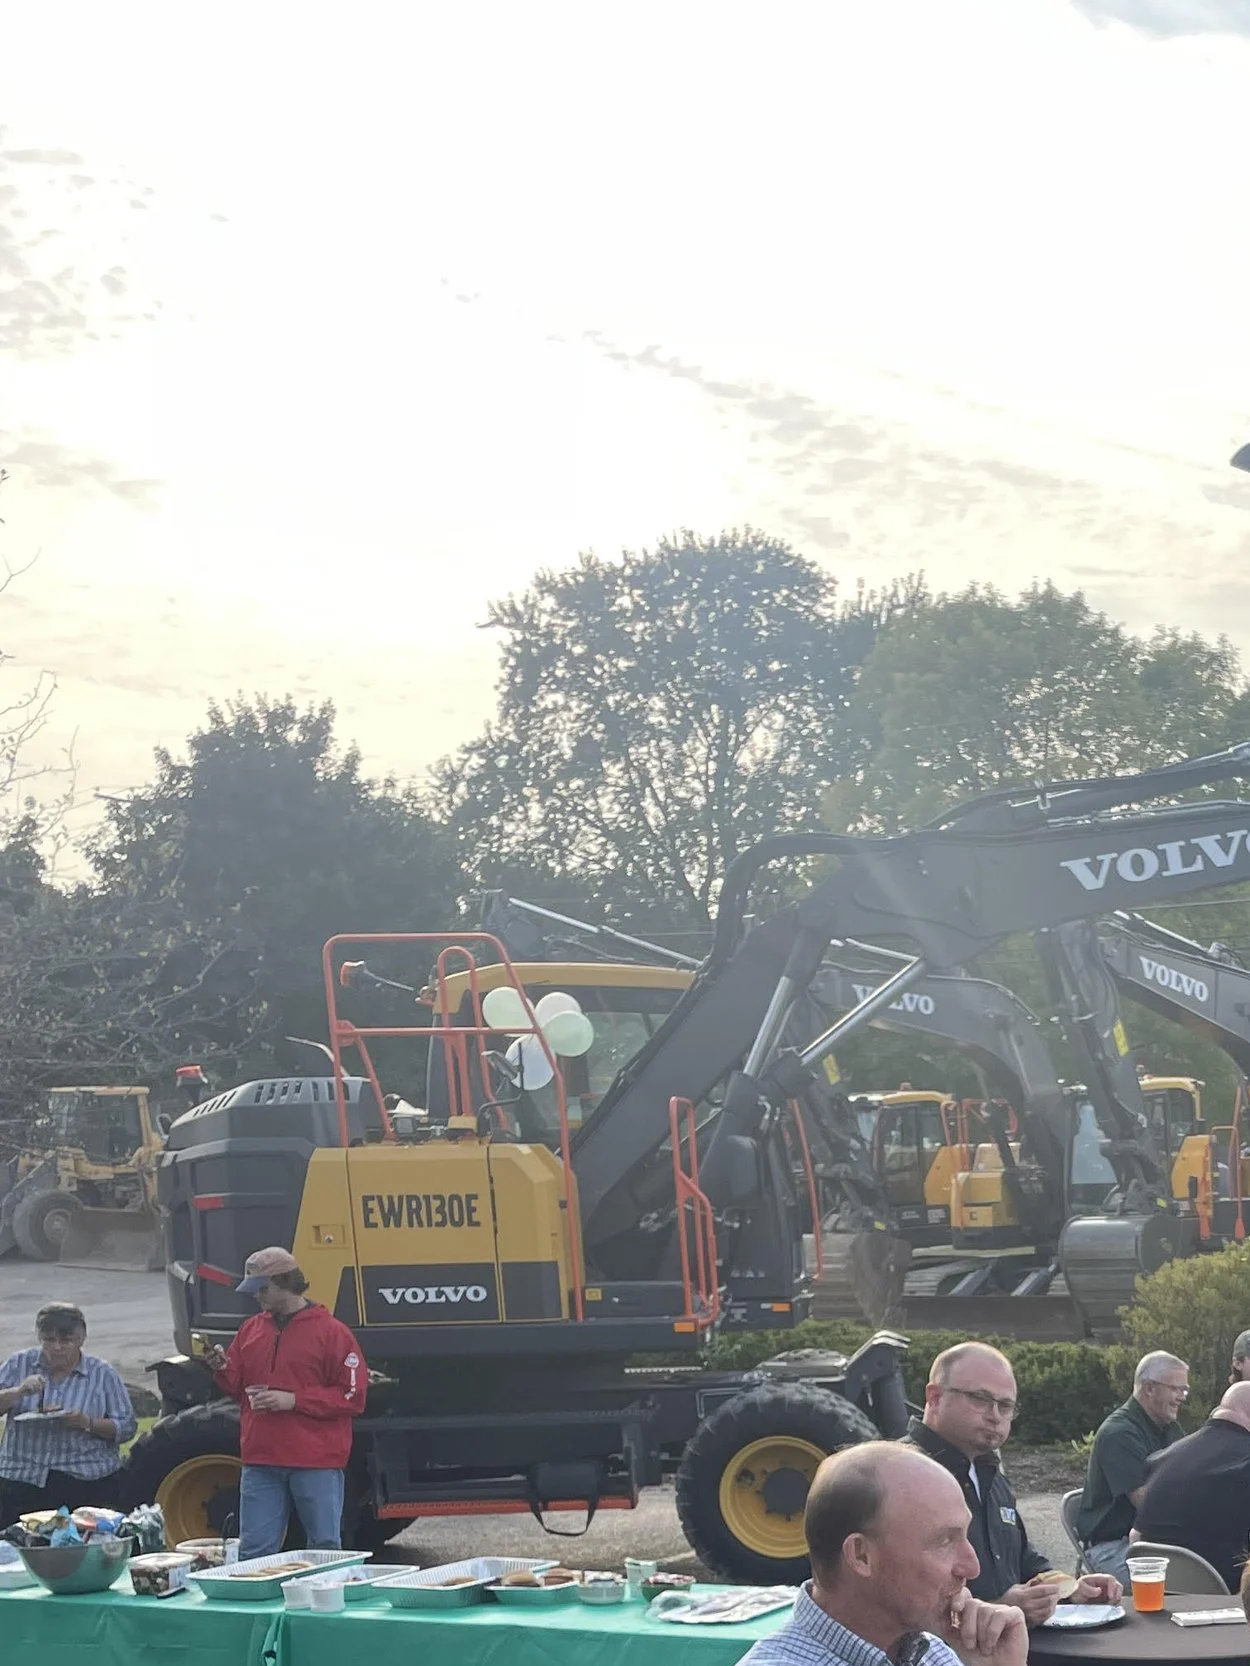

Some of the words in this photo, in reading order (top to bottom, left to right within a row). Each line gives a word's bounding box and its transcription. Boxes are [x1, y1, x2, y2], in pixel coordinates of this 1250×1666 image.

[1139, 957, 1208, 1001] VOLVO
[361, 1193, 482, 1228] EWR130E
[378, 1286, 487, 1303] VOLVO
